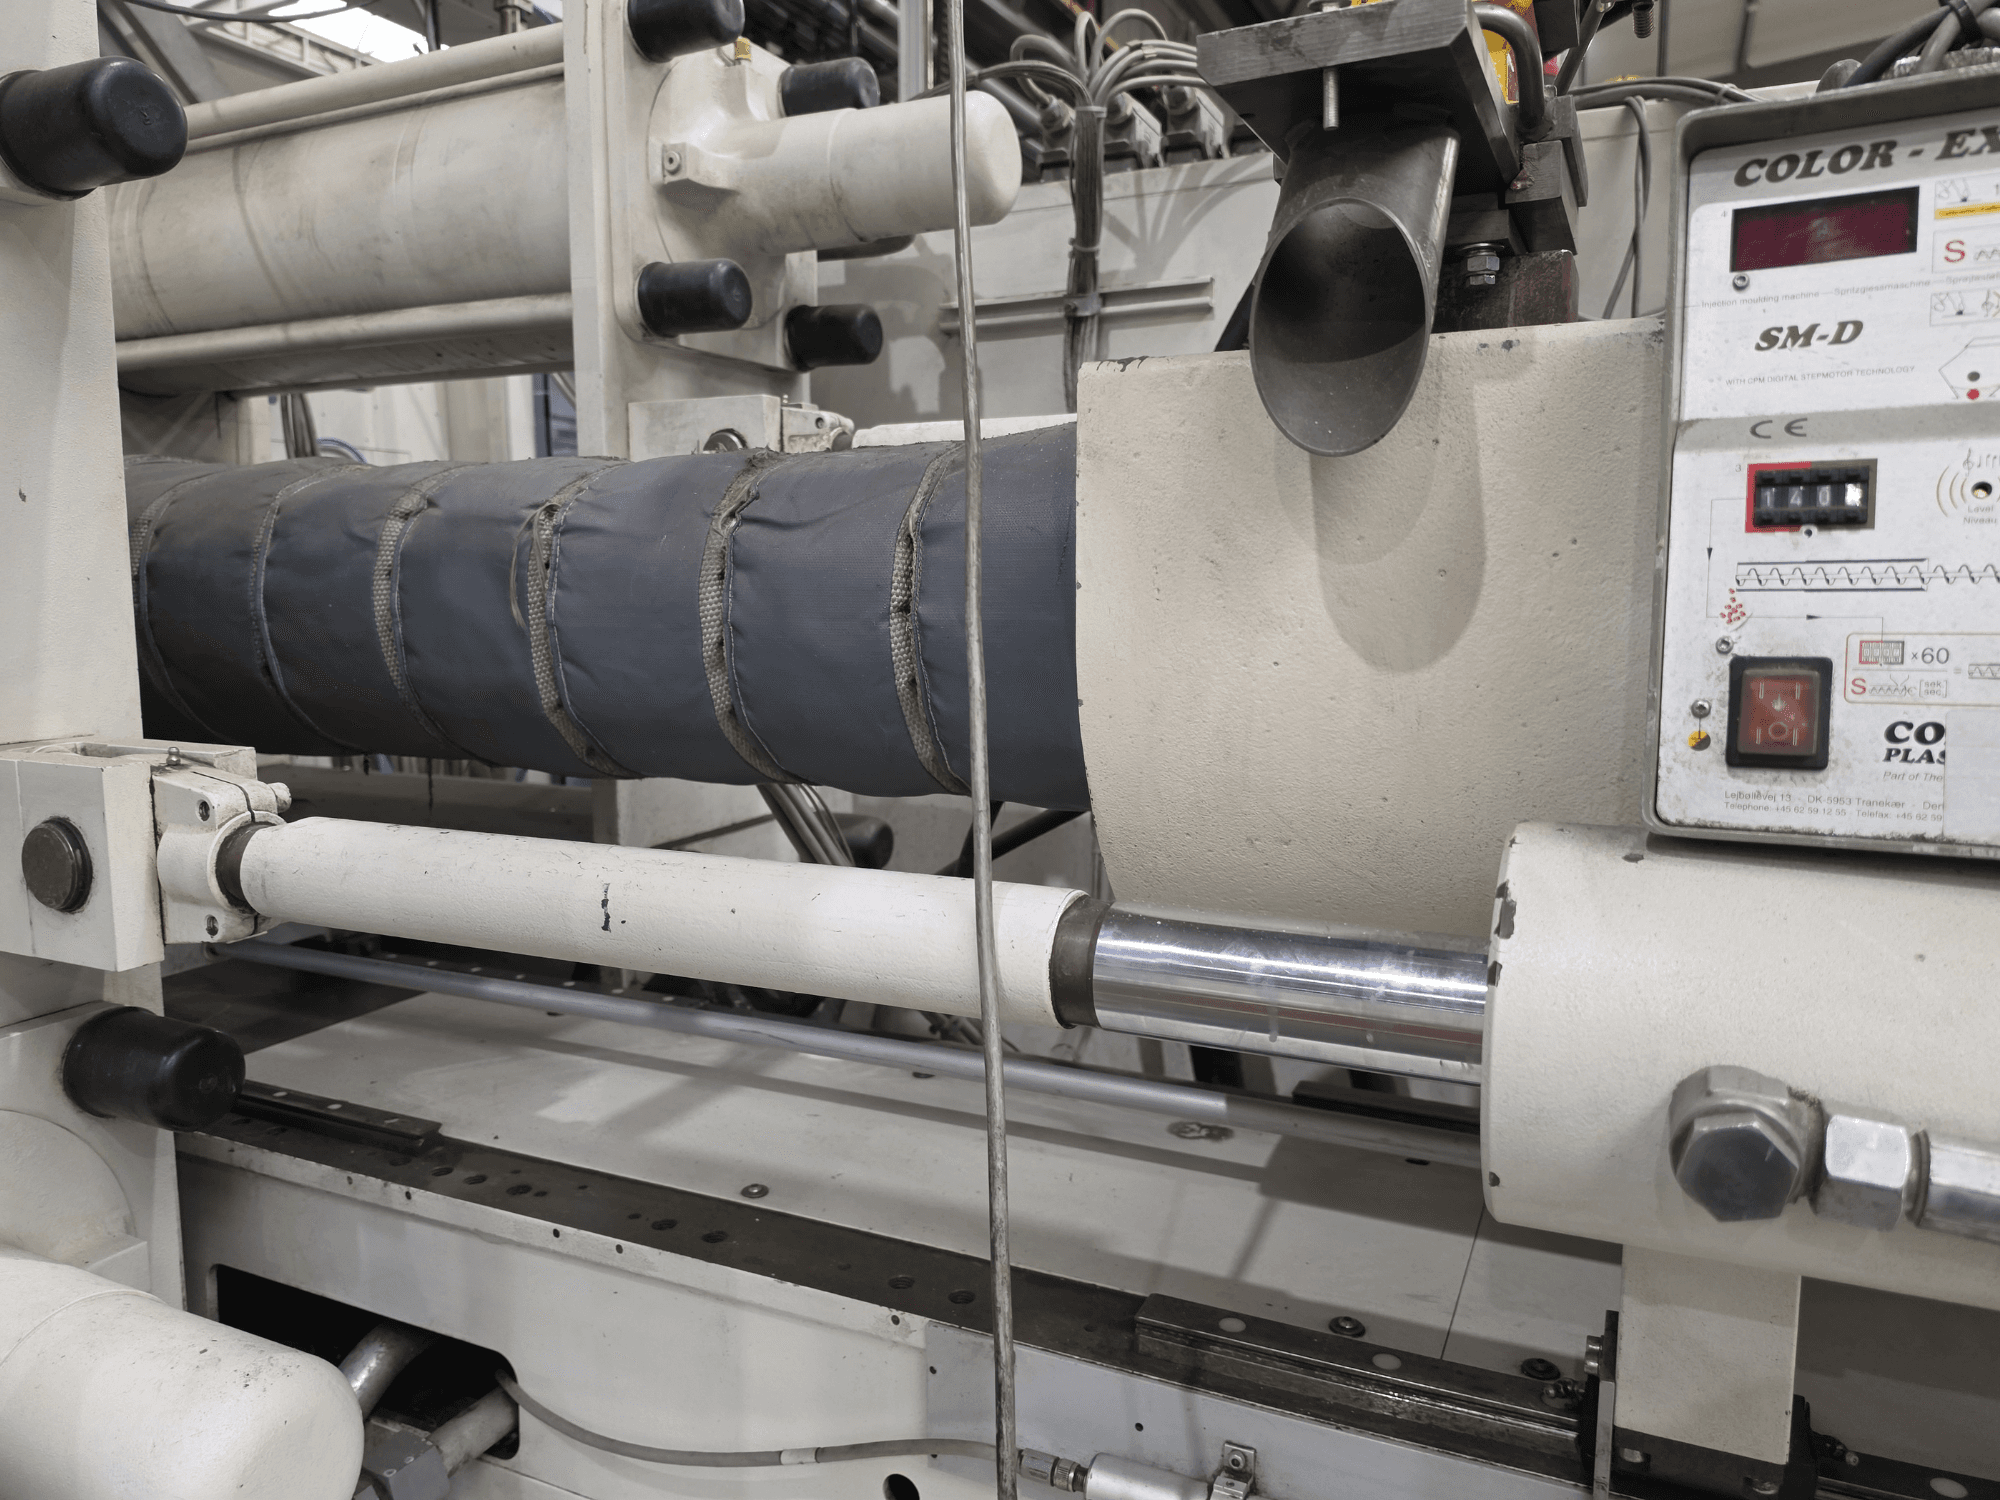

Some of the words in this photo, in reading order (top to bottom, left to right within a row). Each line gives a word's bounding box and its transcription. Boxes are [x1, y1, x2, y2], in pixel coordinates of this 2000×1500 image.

[1733, 139, 1898, 187] COLOR
[1944, 240, 1966, 263] S
[1701, 299, 1737, 309] Injection
[1740, 294, 1779, 305] moulding
[1782, 291, 1820, 301] machine
[1754, 320, 1864, 351] SM-D
[1725, 378, 1746, 387] WITH
[1748, 376, 1765, 385] CPM
[1767, 374, 1798, 383] DIGITAL
[1801, 370, 1853, 381] STEPMOTOR
[1856, 365, 1915, 377] TECHNOLOGY
[1967, 505, 1994, 513] Level
[1963, 517, 1997, 525] Niveau
[1884, 720, 1946, 746] CO
[1882, 771, 1906, 781] Part
[1908, 772, 1919, 781] of
[1924, 772, 1943, 782] The
[1723, 802, 1772, 812] Telephone:
[1775, 805, 1791, 813] +45
[1794, 806, 1805, 814] 62
[1823, 808, 1833, 816] 12
[1835, 808, 1847, 816] 55
[1781, 793, 1792, 802] 13
[1855, 797, 1905, 808] Tranekær
